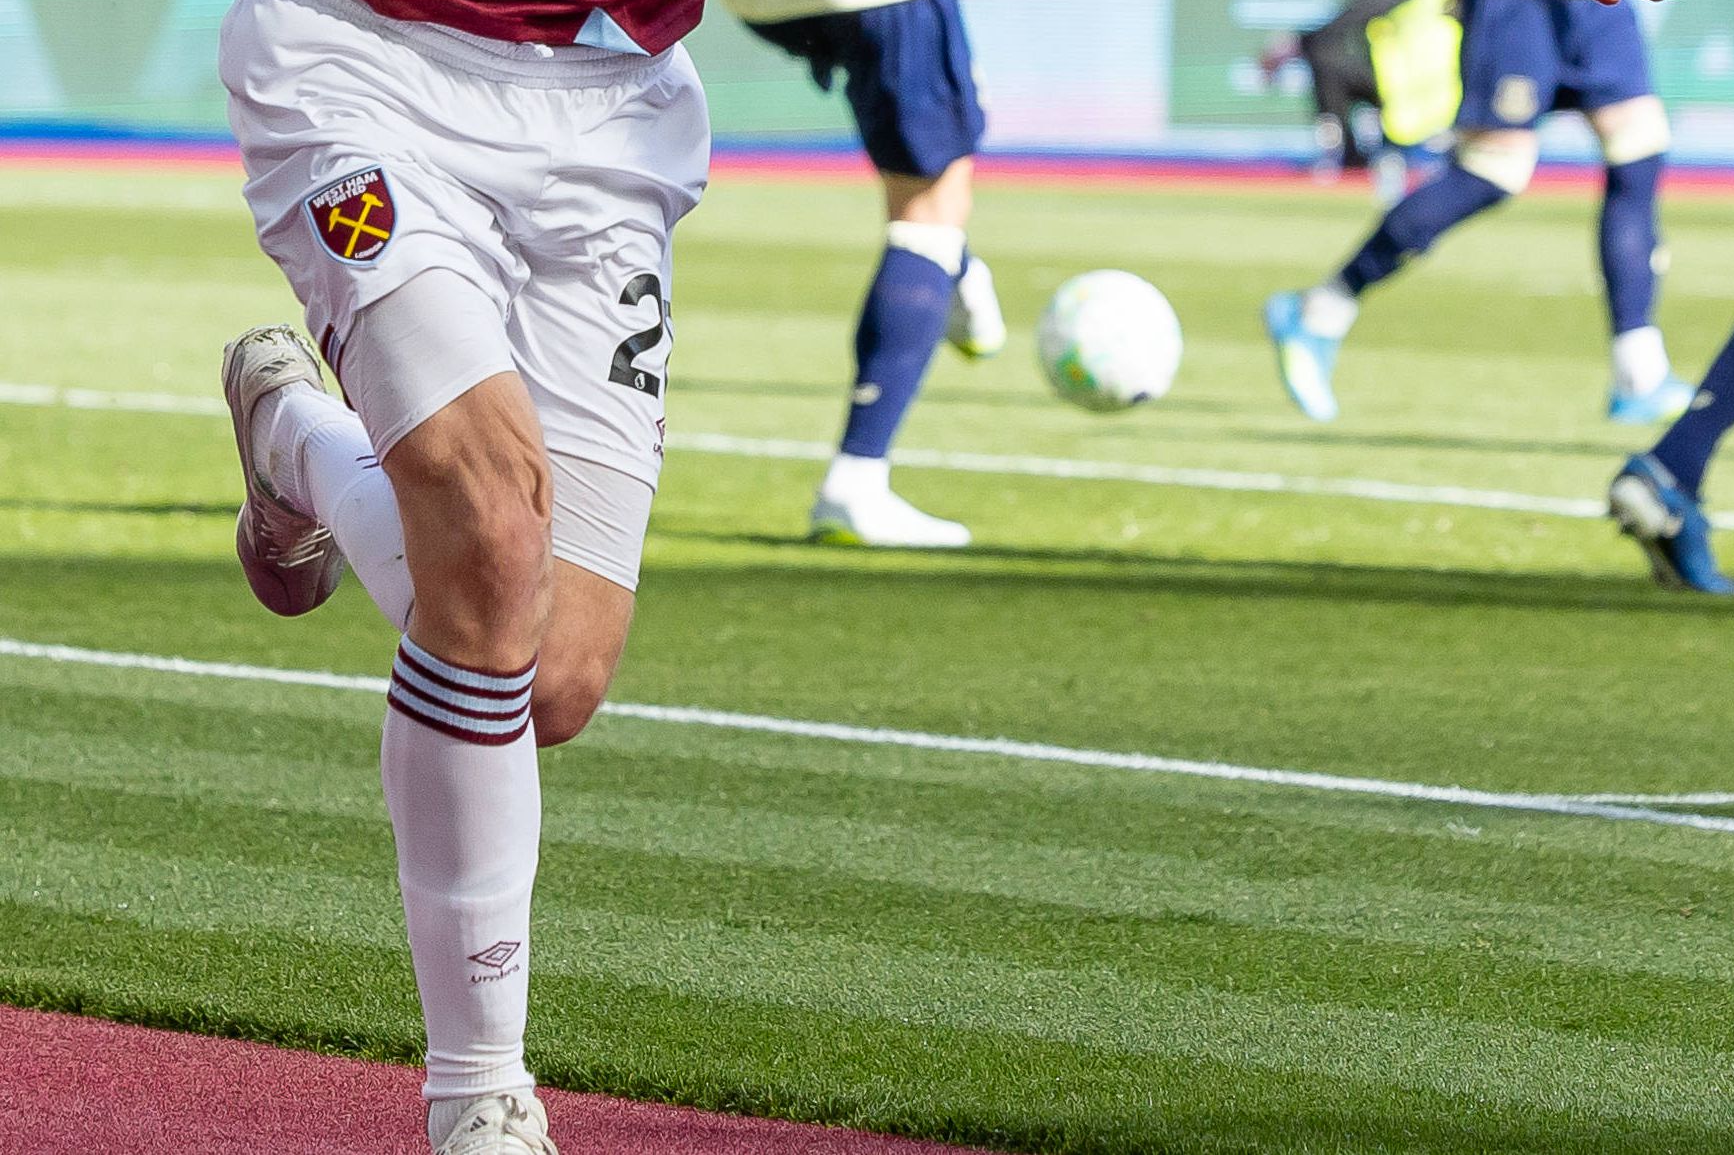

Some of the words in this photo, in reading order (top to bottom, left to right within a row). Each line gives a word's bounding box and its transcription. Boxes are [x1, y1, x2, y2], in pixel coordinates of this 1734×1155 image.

[312, 184, 343, 208] WEST
[345, 172, 379, 191] HAM
[328, 185, 367, 208] UNITED
[608, 273, 673, 400] 2
[471, 964, 520, 983] umbro
